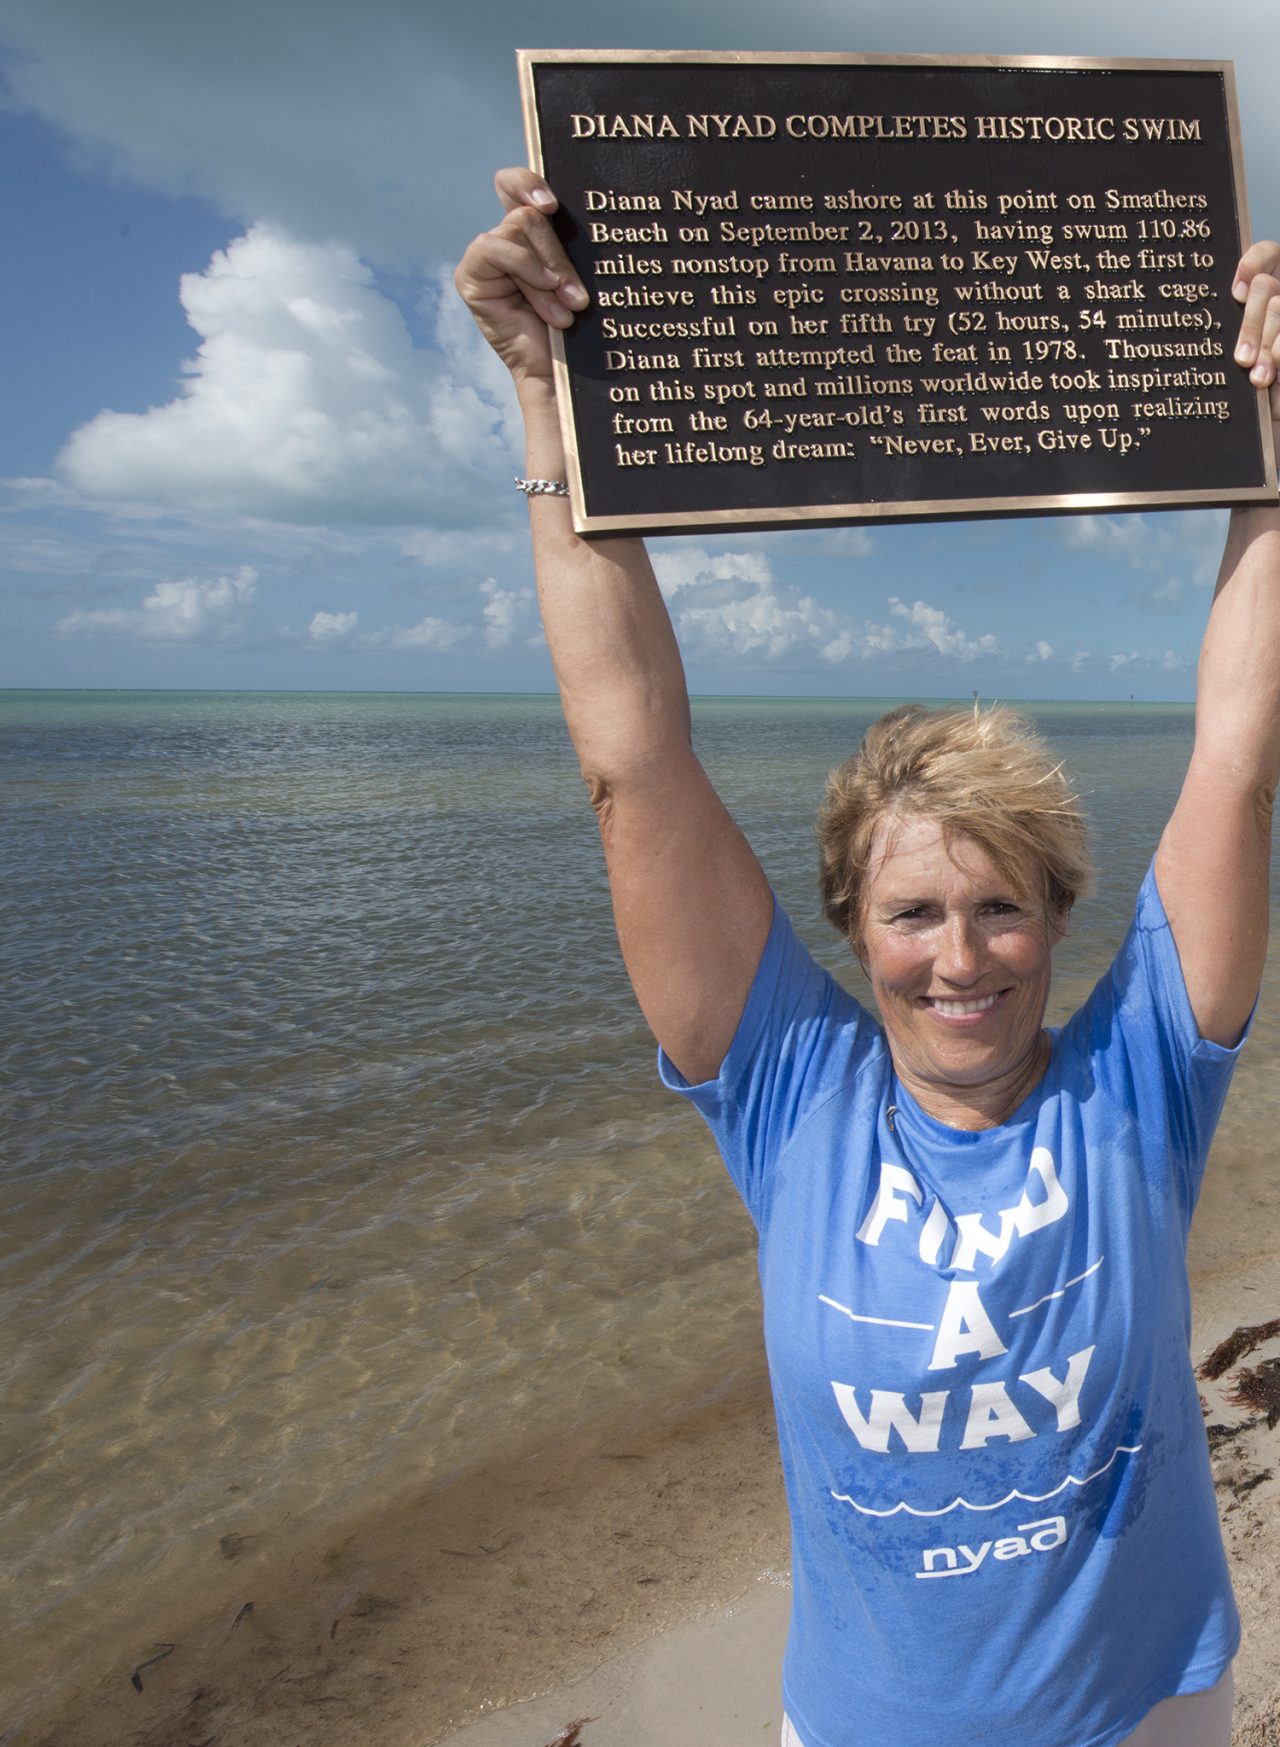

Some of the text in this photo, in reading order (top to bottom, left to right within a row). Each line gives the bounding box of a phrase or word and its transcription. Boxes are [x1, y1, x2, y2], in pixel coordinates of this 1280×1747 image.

[571, 114, 1201, 141] DIANA NYAD COMPLETES HISTORIC SWIM
[586, 189, 1207, 216] Diana Nyad came ashore at this point on Smathers
[591, 219, 1211, 247] Beach on September 2, 2013, having swum 110.86
[595, 250, 1214, 279] miles nonstop from Havana to Key West, the first to
[598, 281, 1217, 309] achieve this epic crossing without a shark cage.
[602, 307, 1221, 338] Successful on her fifth try (52 hours, 54 minutes),
[606, 339, 1223, 370] Diana first attempted the feat in 1978. Thousands
[609, 369, 1226, 405] on this spot and millions worldwide took inspiration
[613, 413, 673, 434] from
[689, 411, 727, 432] the
[918, 403, 967, 423] first
[982, 401, 1050, 421] words
[1063, 403, 1119, 424] upon
[1133, 399, 1230, 420] realizing
[616, 444, 657, 465] her
[665, 442, 764, 465] lifelong
[773, 438, 855, 459] dream:
[870, 434, 963, 456] “Never,
[970, 432, 1031, 454] Ever,
[1038, 430, 1091, 449] Give
[856, 1146, 1068, 1271] FIND
[928, 1280, 1008, 1370] A
[830, 1345, 1096, 1453] WAY
[915, 1515, 1067, 1578] nyad
